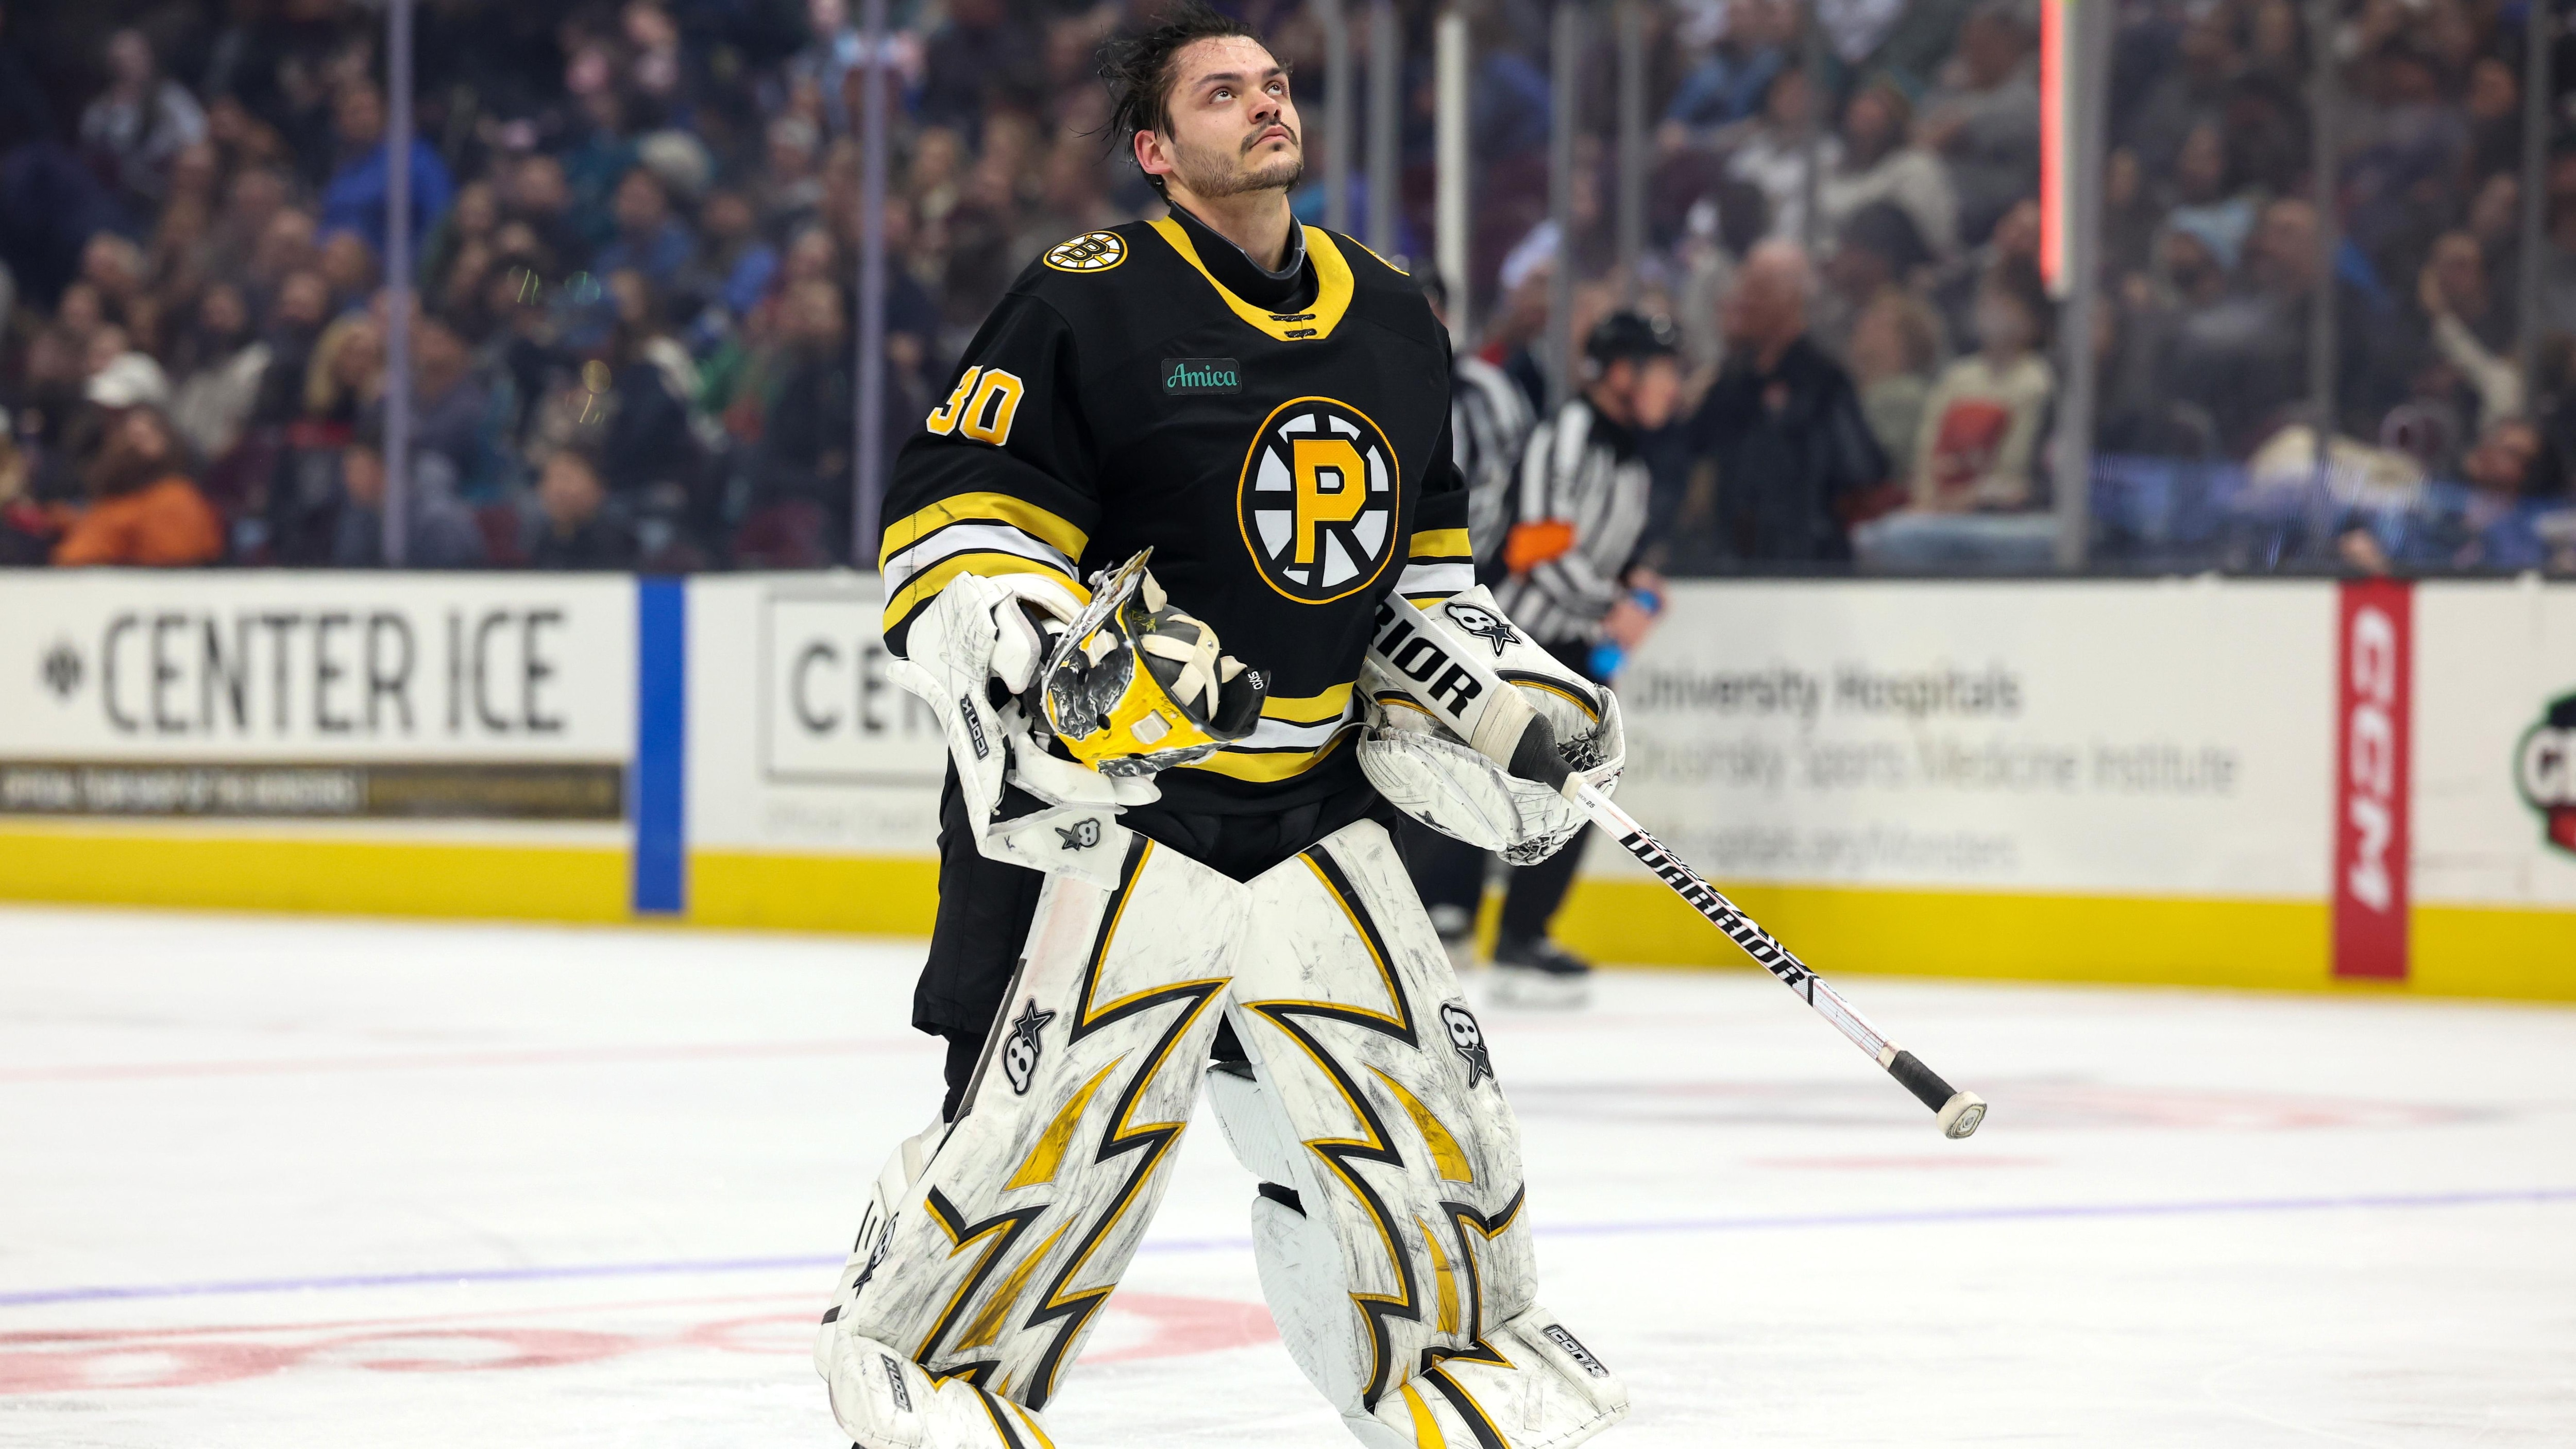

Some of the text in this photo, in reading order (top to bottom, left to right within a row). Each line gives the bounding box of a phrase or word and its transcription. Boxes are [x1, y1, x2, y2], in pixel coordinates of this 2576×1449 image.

[926, 365, 1025, 447] 30
[1167, 363, 1238, 388] Amica
[99, 604, 569, 737] CENTER ICE
[1627, 662, 2025, 729] University Hospitals
[2349, 604, 2397, 915] CCM
[1619, 831, 1806, 987] WARRIOR
